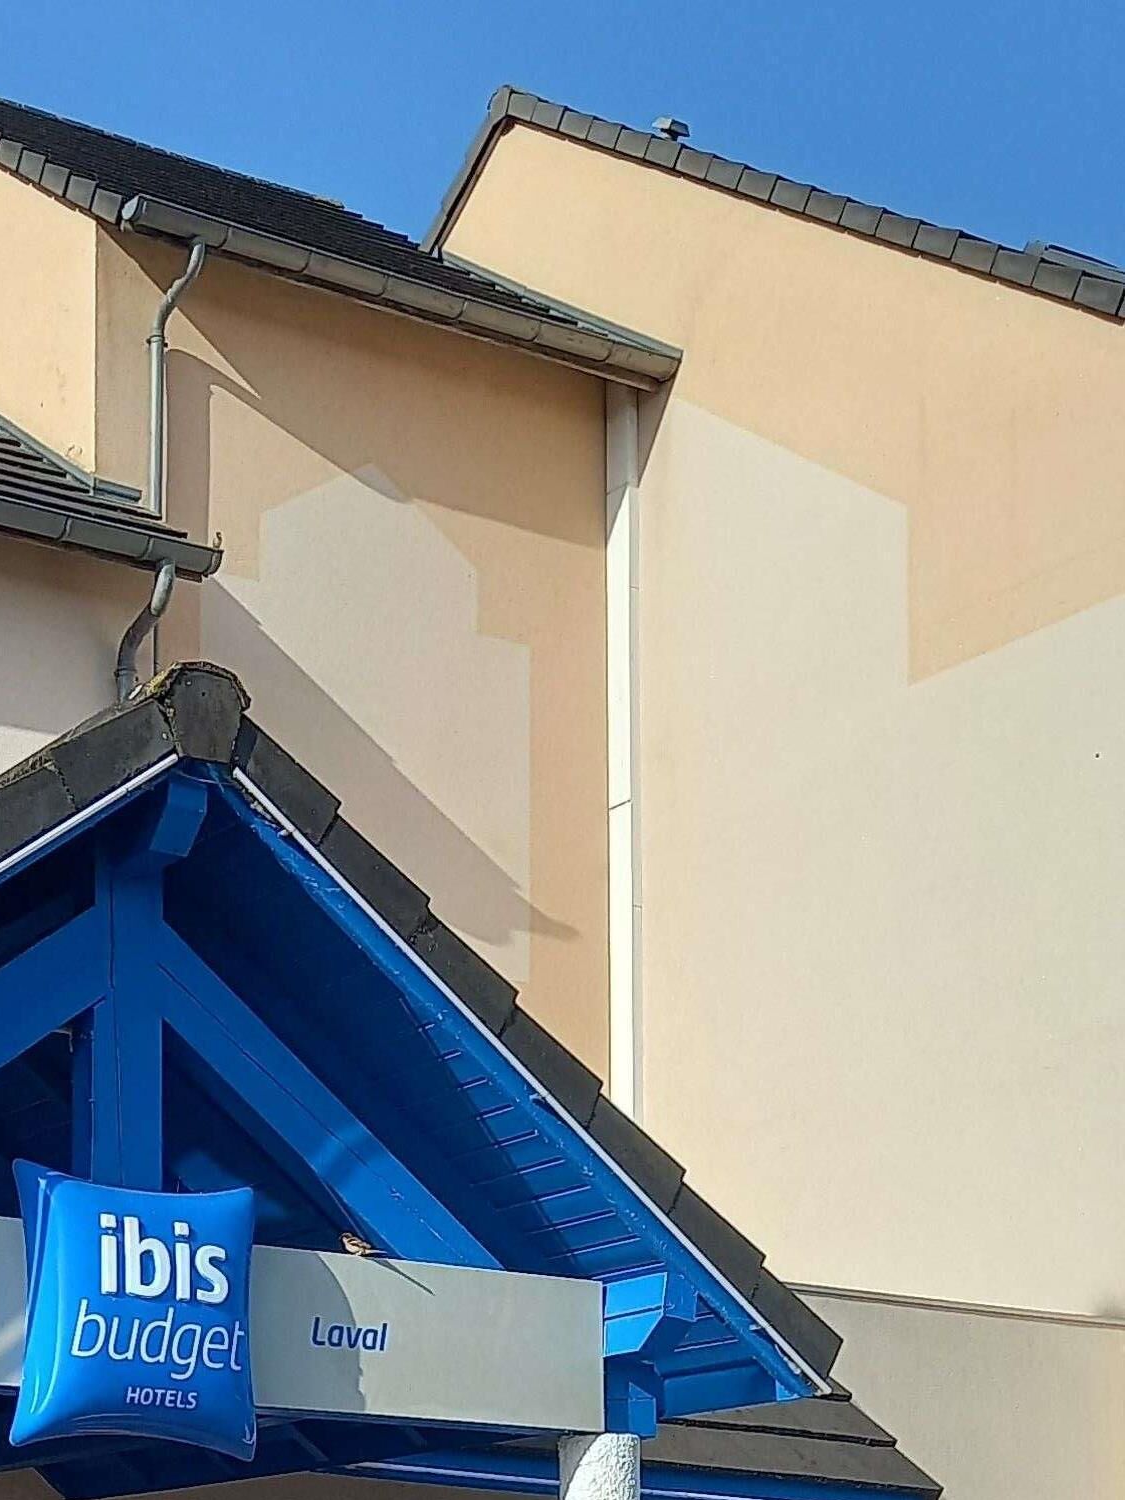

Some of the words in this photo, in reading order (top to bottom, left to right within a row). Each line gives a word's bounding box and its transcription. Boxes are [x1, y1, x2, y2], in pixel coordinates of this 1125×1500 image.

[100, 1213, 229, 1304] ibis
[71, 1299, 245, 1380] budget
[311, 1316, 388, 1352] Laval
[126, 1386, 198, 1409] HOTELS
